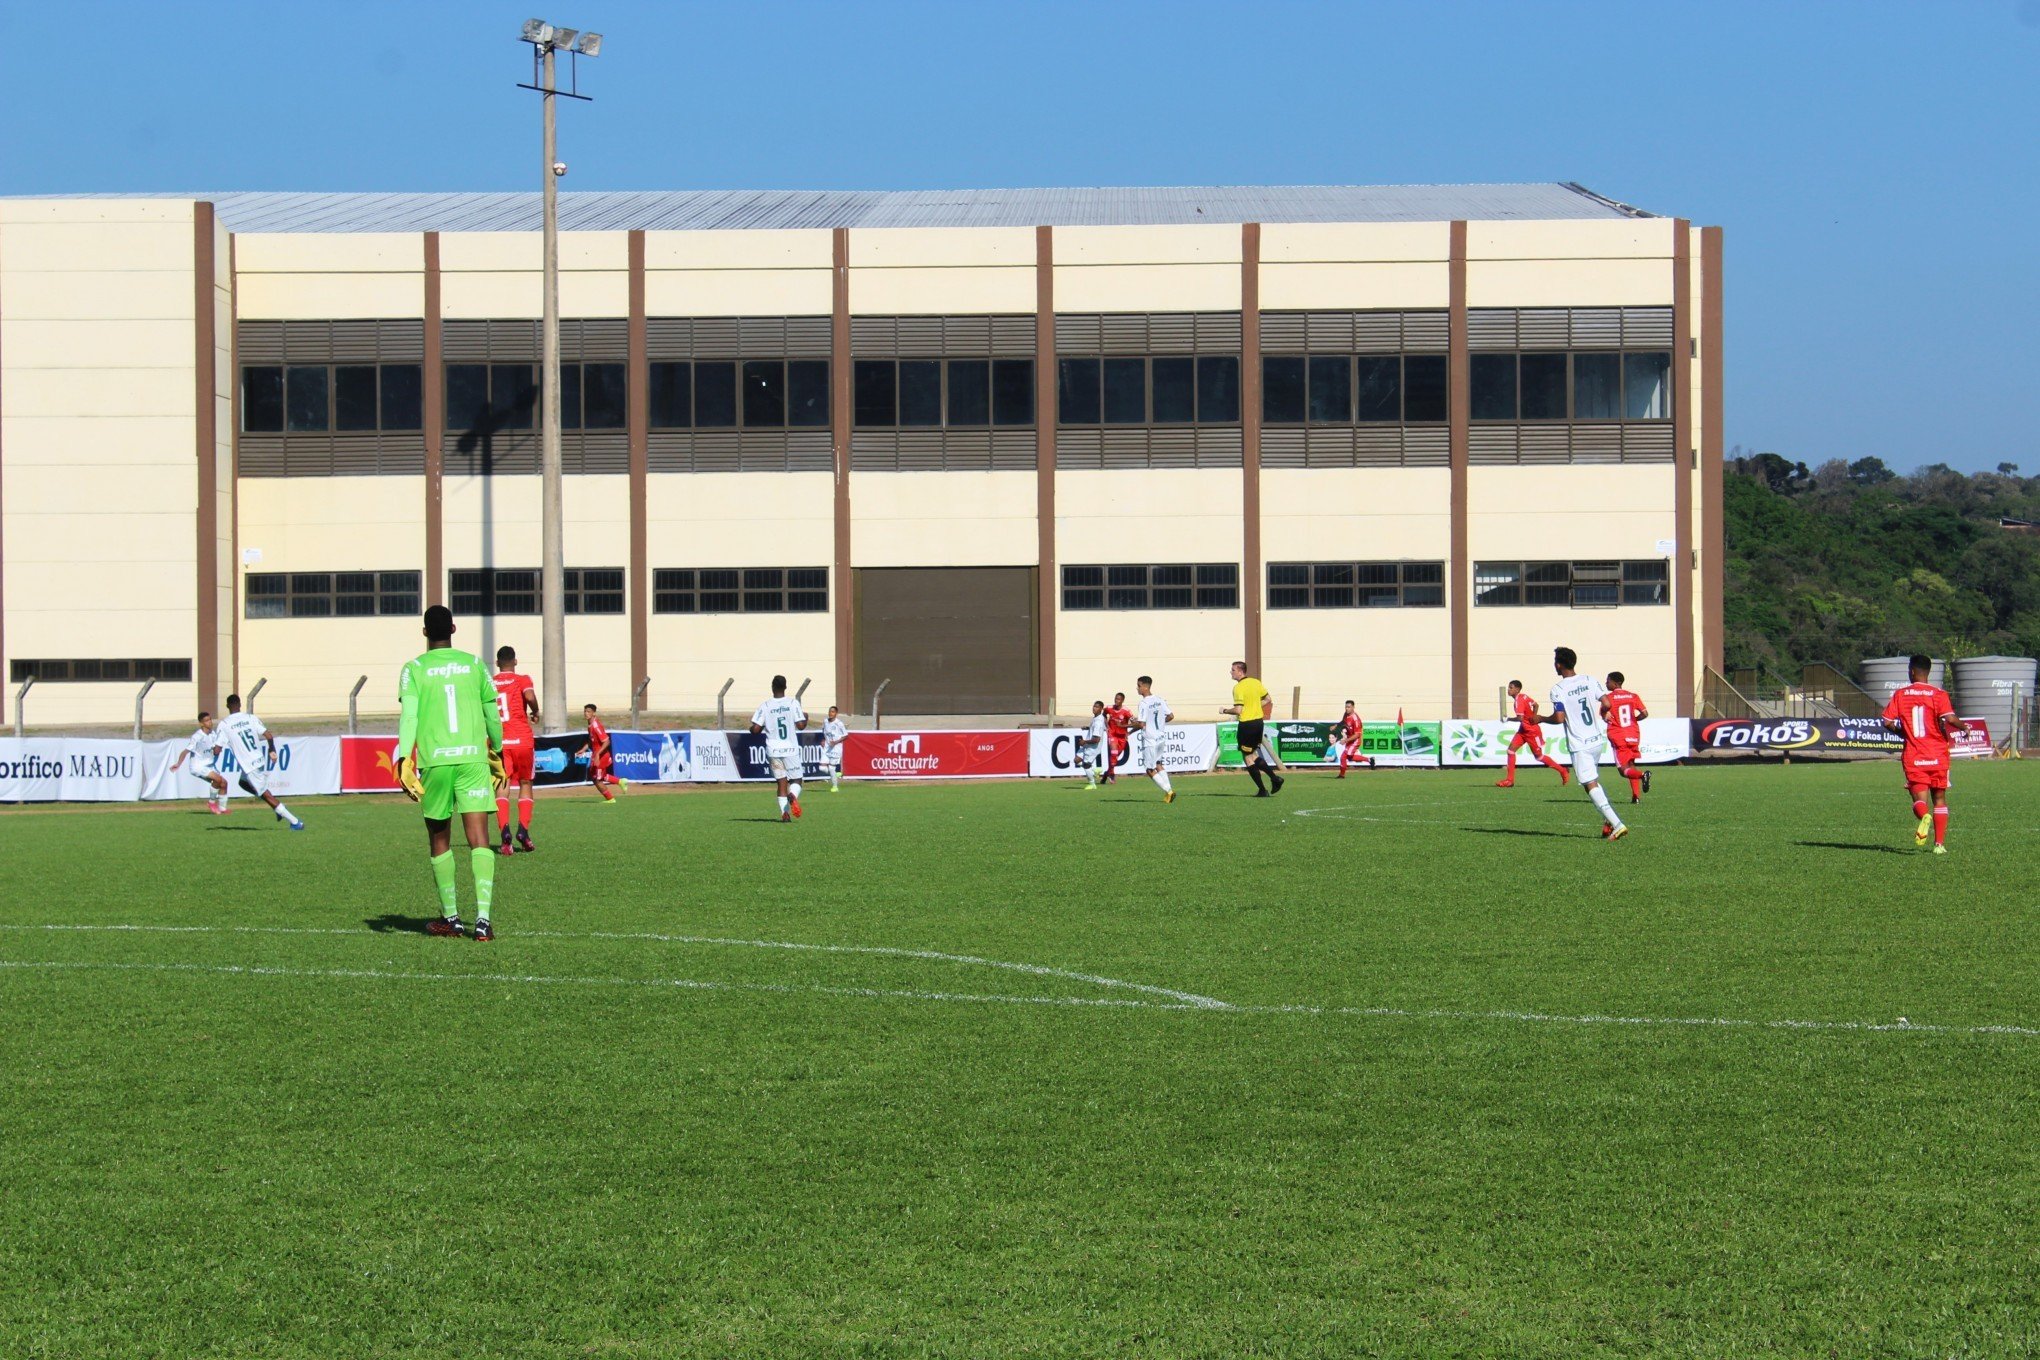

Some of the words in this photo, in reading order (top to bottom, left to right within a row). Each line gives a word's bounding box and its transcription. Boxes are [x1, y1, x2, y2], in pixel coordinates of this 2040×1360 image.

[427, 662, 470, 678] crefisa
[444, 684, 458, 733] 1
[1578, 697, 1593, 726] 3
[1618, 704, 1631, 728] 8
[777, 717, 787, 740] 5
[1912, 705, 1926, 738] 11
[238, 729, 257, 752] 15
[1856, 731, 1881, 741] Fokos
[69, 755, 134, 778] MADU
[614, 751, 647, 766] crystal
[871, 754, 939, 770] construarte
